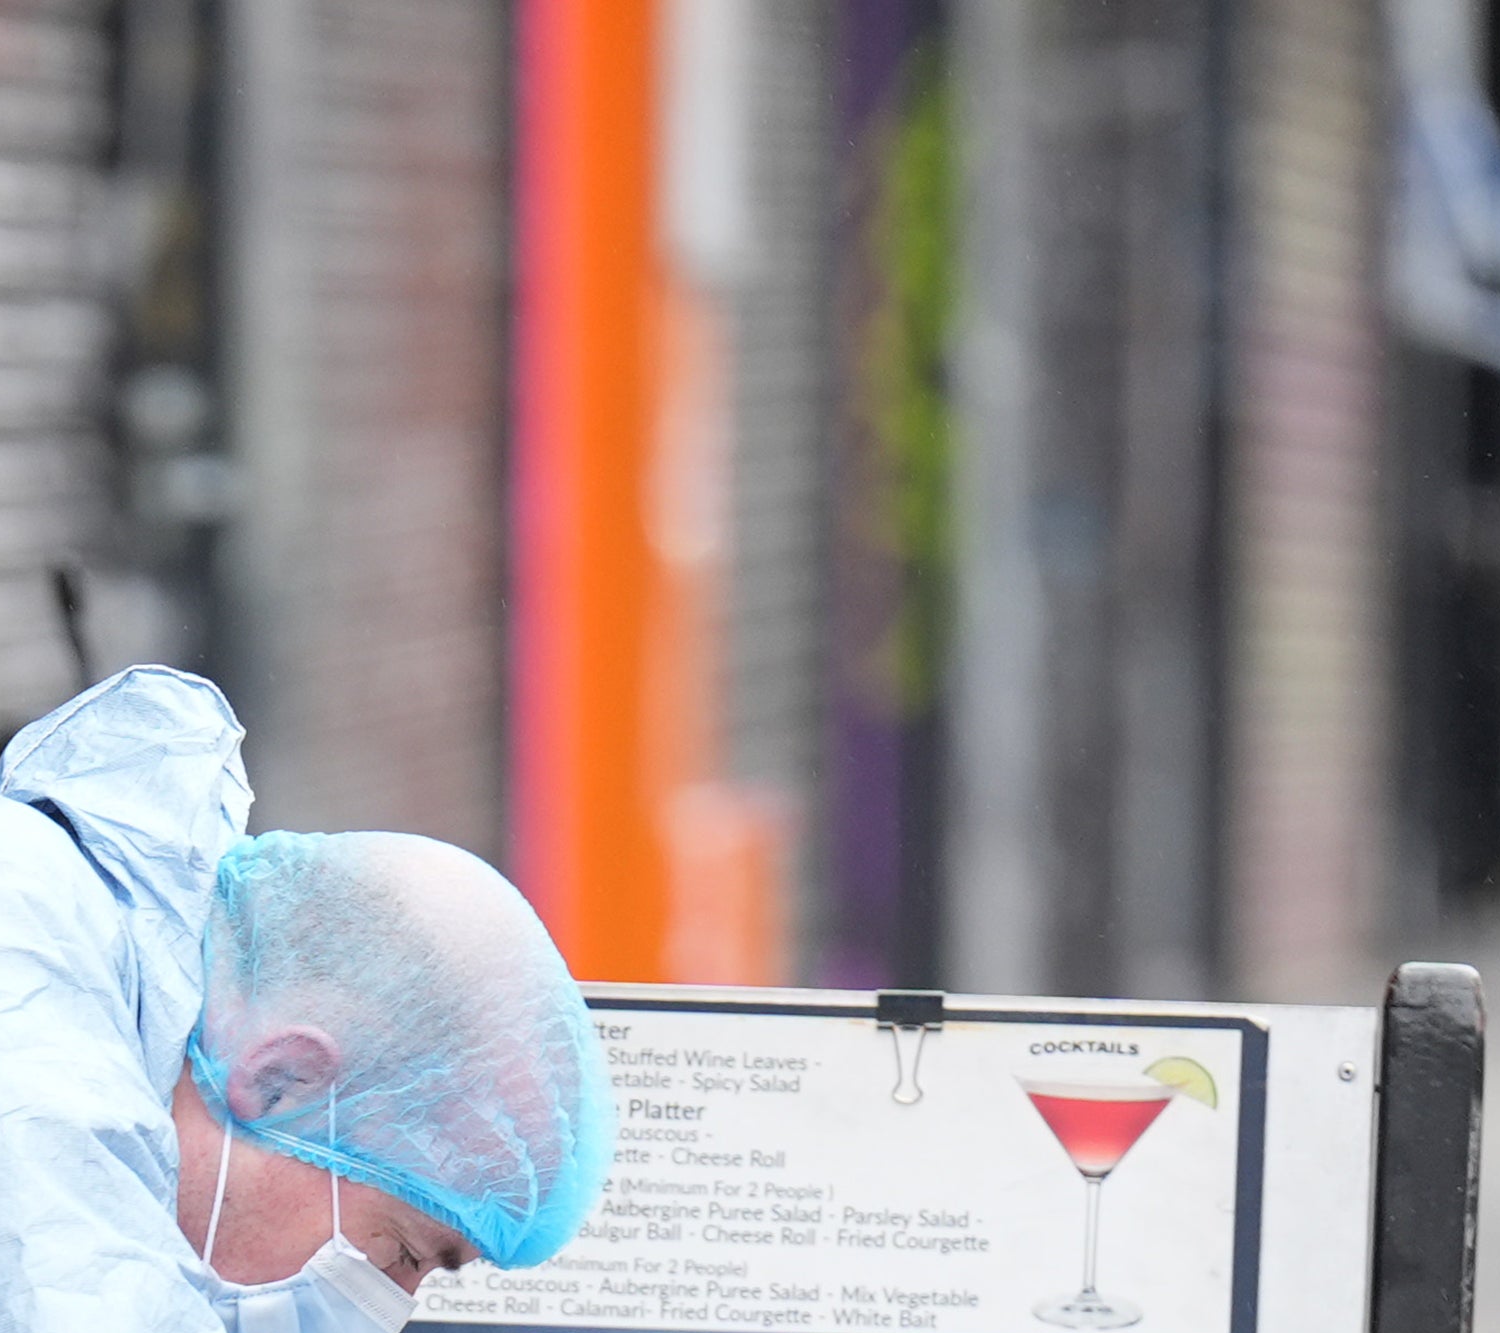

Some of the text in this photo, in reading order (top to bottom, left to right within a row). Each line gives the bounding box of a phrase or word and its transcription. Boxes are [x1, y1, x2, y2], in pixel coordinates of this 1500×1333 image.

[606, 1046, 808, 1072] Stuffed Wine Leaves
[1028, 1038, 1140, 1057] COCKTAILS
[611, 1071, 801, 1095] etable Spicy Salad
[628, 1098, 708, 1121] Platter
[616, 1126, 700, 1142] ouscous
[671, 1146, 743, 1168] Cheese
[749, 1149, 787, 1169] Roll
[619, 1178, 709, 1197] (Minimum
[713, 1180, 744, 1198] For
[747, 1181, 760, 1199] 2
[763, 1182, 825, 1202] People
[601, 1199, 971, 1230] Aubergine Puree Salad Parsley Salad
[646, 1222, 682, 1242] Ball
[702, 1224, 775, 1244] Cheese
[780, 1226, 817, 1246] Roll
[837, 1229, 887, 1249] Fried
[891, 1231, 991, 1256] Courgette
[633, 1257, 662, 1275] For
[667, 1258, 680, 1275] 2
[683, 1259, 749, 1279] People)
[485, 1272, 580, 1293] Couscous
[599, 1278, 700, 1302] Aubergine
[706, 1280, 763, 1300] Puree
[769, 1282, 820, 1302] Salad
[841, 1285, 877, 1303] Mix
[881, 1286, 980, 1310] Vegetable
[424, 1293, 498, 1314] Cheese
[503, 1296, 541, 1316] Roll
[659, 1300, 709, 1321] Fried
[714, 1303, 813, 1327] Courgette
[832, 1308, 893, 1328] White
[899, 1309, 938, 1330] Bait
